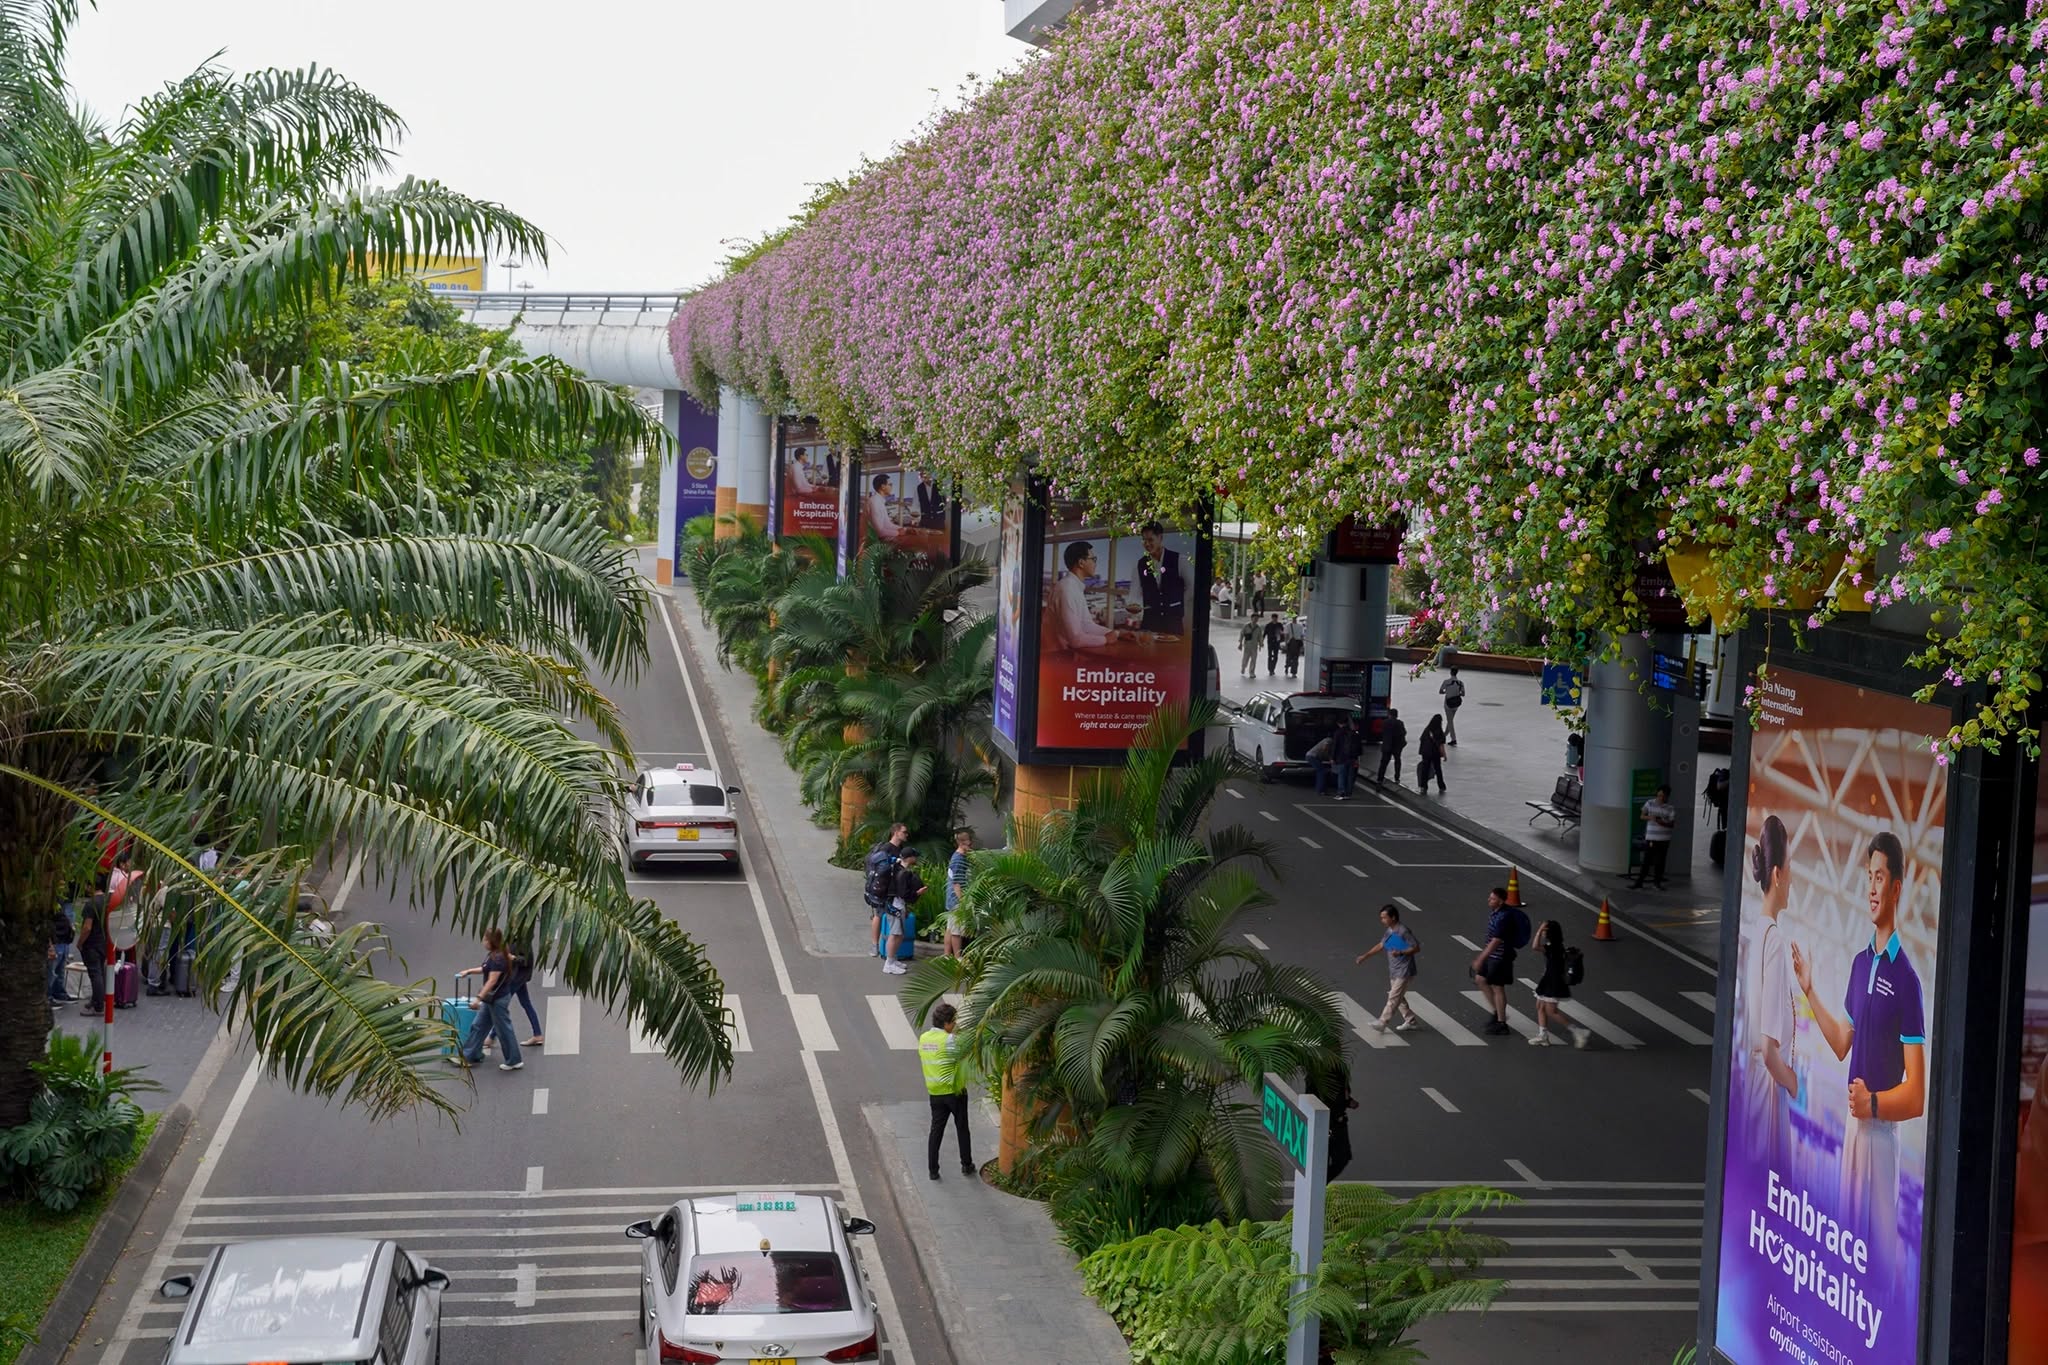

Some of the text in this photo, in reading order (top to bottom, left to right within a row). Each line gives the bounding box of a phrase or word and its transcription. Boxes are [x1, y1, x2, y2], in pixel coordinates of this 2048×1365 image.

[799, 502, 835, 510] Embrace
[1640, 576, 1673, 586] Embra
[1076, 667, 1155, 684] Embrace
[1762, 680, 1796, 701] Da Nang
[1761, 696, 1803, 716] International
[1074, 712, 1095, 720] Where
[1097, 712, 1113, 720] taste
[1114, 712, 1120, 720] &
[1760, 711, 1785, 725] Airport
[1080, 721, 1098, 731] right
[1276, 1096, 1308, 1169] TAXI
[774, 1201, 784, 1211] 83
[1767, 1169, 1868, 1274] Embrace
[1767, 1293, 1801, 1333] Airport
[1769, 1326, 1806, 1364] anytime
